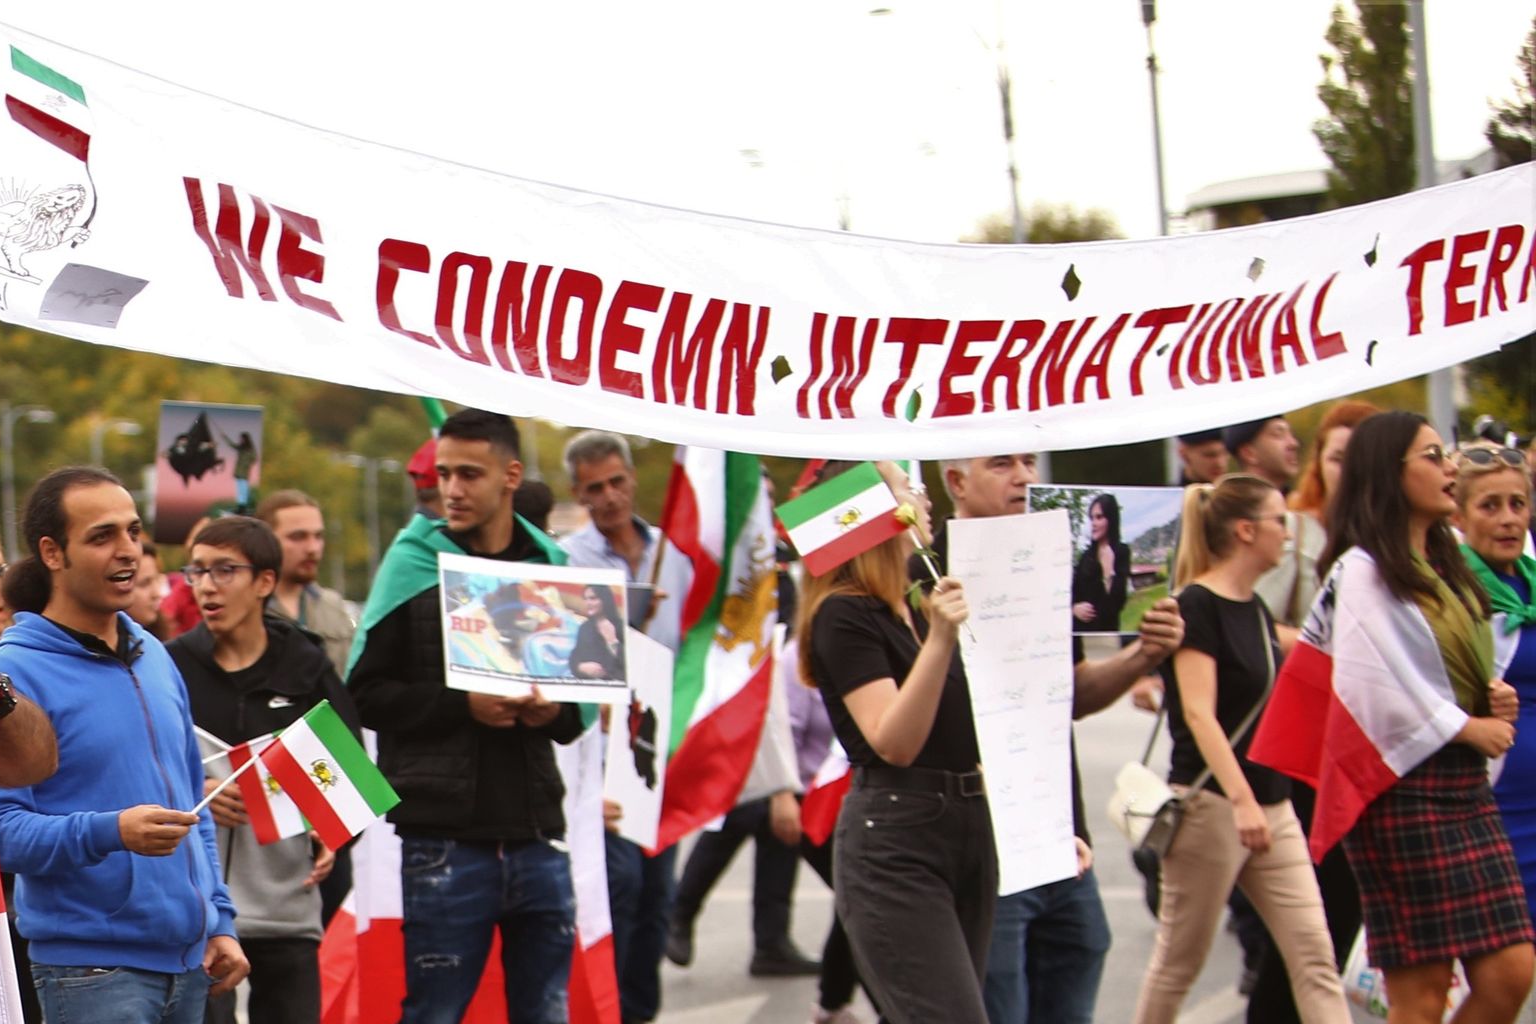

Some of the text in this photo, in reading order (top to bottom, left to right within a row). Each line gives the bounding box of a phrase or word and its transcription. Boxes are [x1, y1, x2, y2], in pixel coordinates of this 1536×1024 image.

[183, 177, 343, 322] WE
[376, 238, 770, 416] CONDEMN
[796, 271, 1348, 420] INTERNATIONAL
[450, 615, 486, 634] RIP
